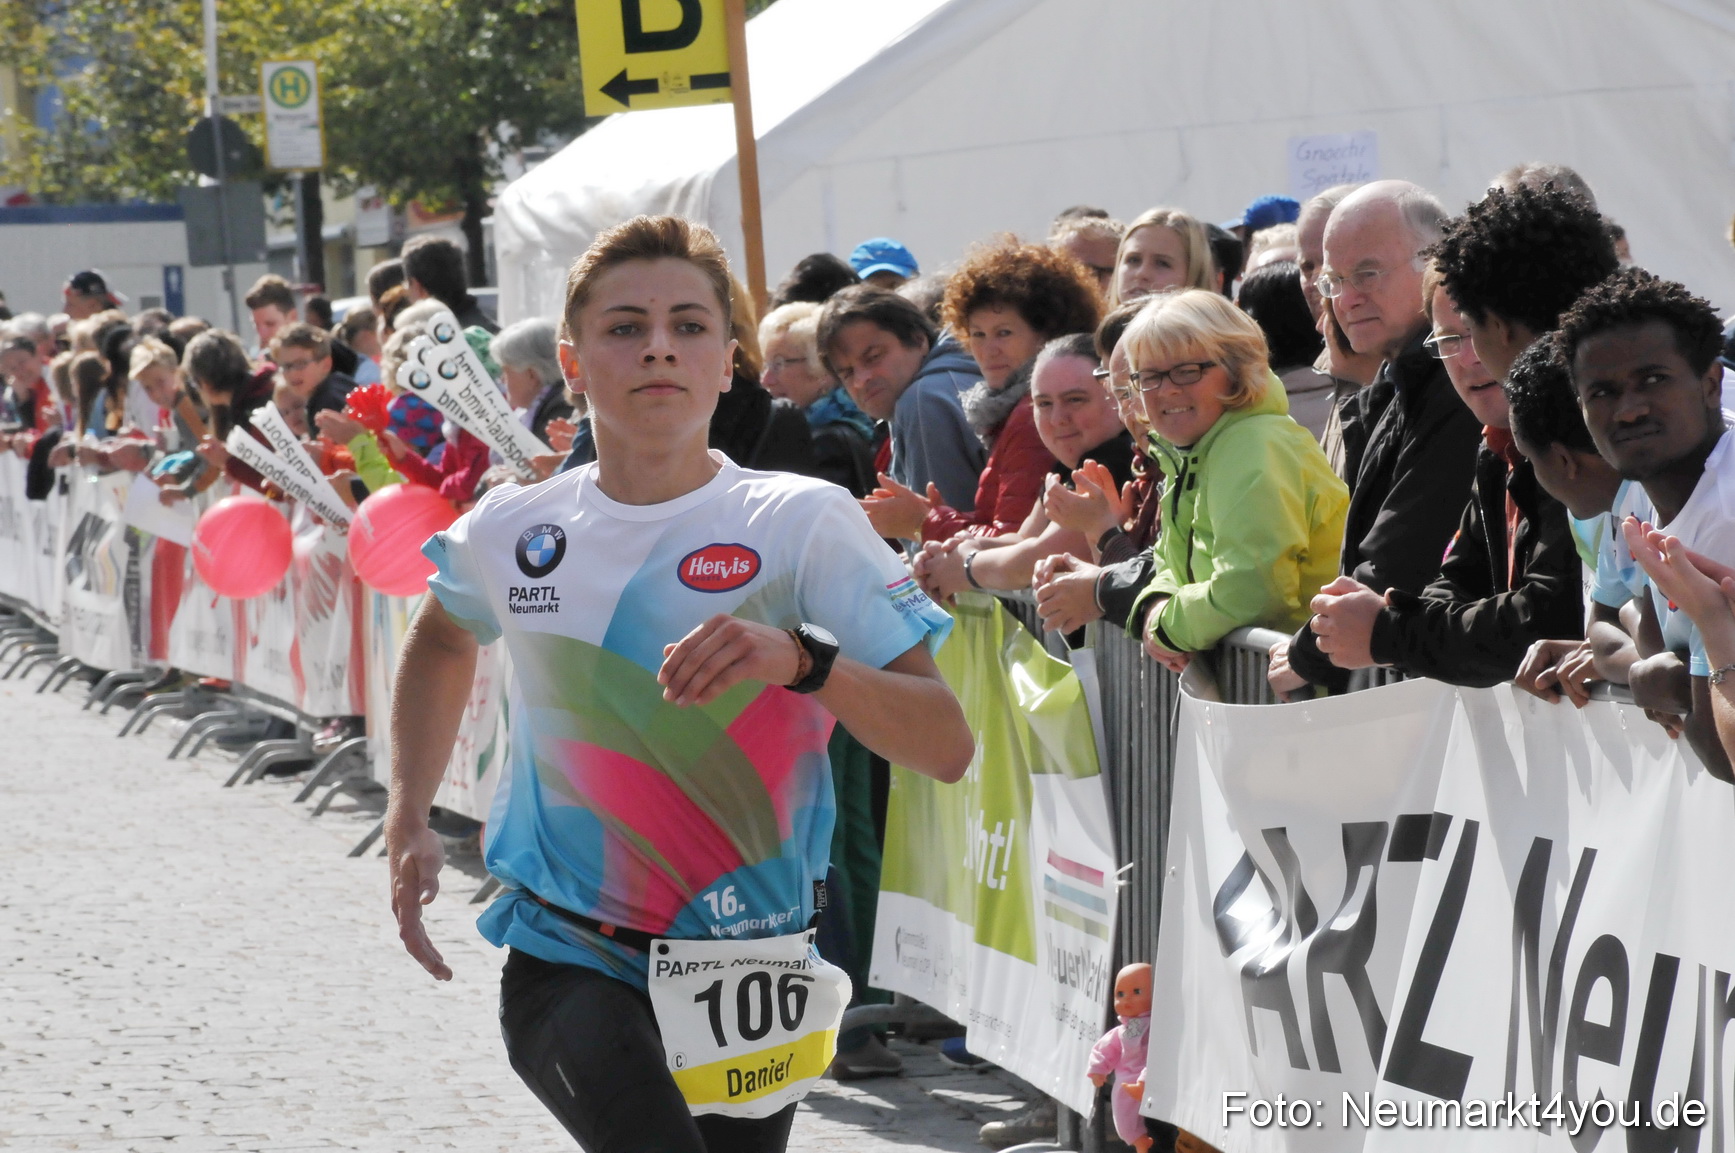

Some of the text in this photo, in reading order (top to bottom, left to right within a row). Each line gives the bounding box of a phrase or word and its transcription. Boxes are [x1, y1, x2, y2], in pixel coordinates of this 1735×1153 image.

[688, 556, 751, 579] Hervis
[508, 586, 561, 602] PARTL
[508, 602, 560, 615] Neumarkt
[703, 885, 745, 921] 16.
[656, 960, 725, 978] PARTL
[694, 971, 815, 1048] 106
[726, 1053, 794, 1098] Daniel
